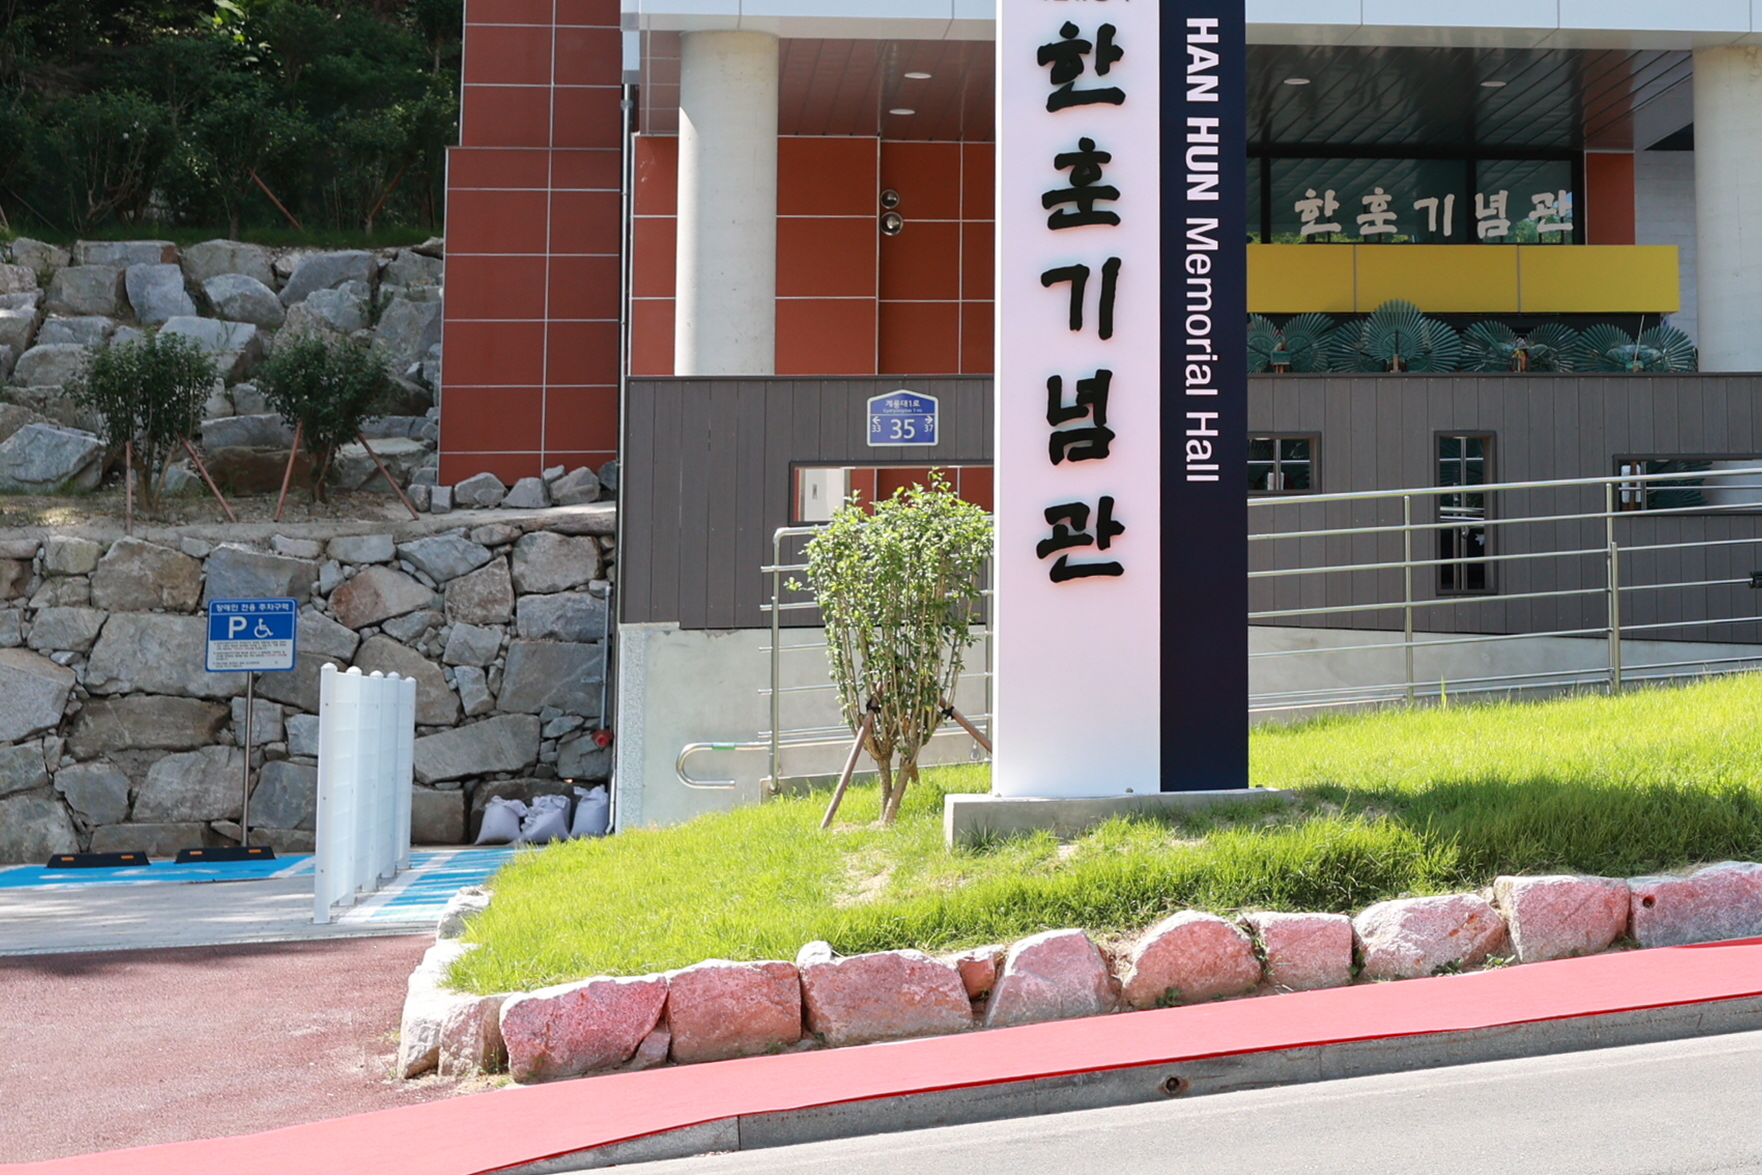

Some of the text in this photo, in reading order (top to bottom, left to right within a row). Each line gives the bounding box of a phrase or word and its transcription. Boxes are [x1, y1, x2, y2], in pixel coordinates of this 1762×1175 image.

[1294, 186, 1574, 239] 한훈기념관
[1185, 17, 1219, 482] HAN HUN Memorial Hall
[1036, 20, 1126, 584] 한훈기념관
[871, 424, 882, 433] 33
[889, 418, 916, 439] 35
[924, 424, 934, 433] 37
[228, 615, 248, 639] P
